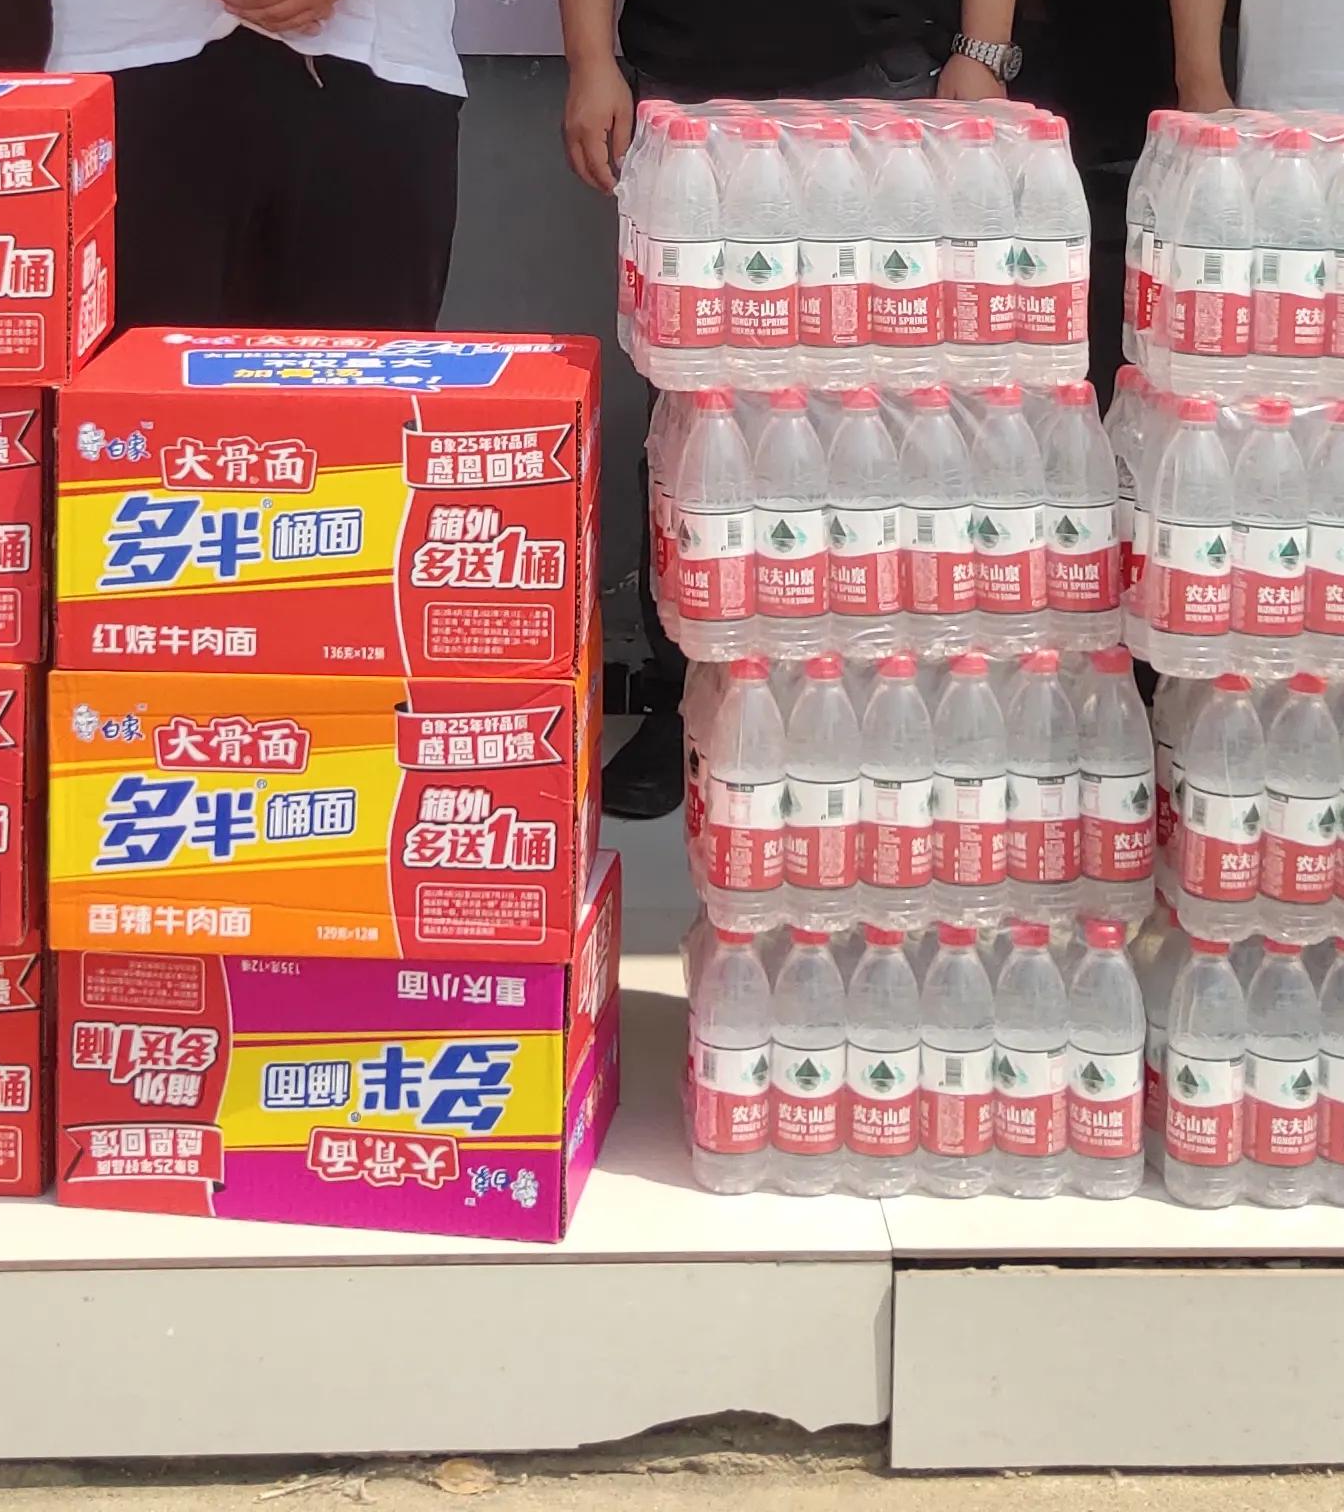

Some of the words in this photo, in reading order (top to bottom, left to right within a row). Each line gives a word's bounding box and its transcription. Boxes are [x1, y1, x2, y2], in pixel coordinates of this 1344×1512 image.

[731, 298, 789, 317] 农夫山泉
[173, 447, 306, 483] 大骨面
[426, 451, 545, 484] 感恩回馈
[430, 507, 498, 540] 箱外
[99, 496, 259, 587] 多半
[273, 510, 362, 559] 桶面
[412, 527, 564, 588] 多送1桶
[91, 624, 256, 656] 红烧牛肉面
[165, 722, 299, 765] 大骨面
[417, 734, 536, 765] 感恩回馈
[96, 777, 255, 867] 多半
[267, 789, 357, 839] 桶面
[421, 788, 490, 821] 箱外
[404, 808, 557, 870] 多送1桶
[88, 905, 251, 936] 香辣牛肉面
[397, 971, 526, 1007] 重庆小面
[73, 1022, 218, 1083] 多送1桶
[133, 1072, 203, 1107] 箱外
